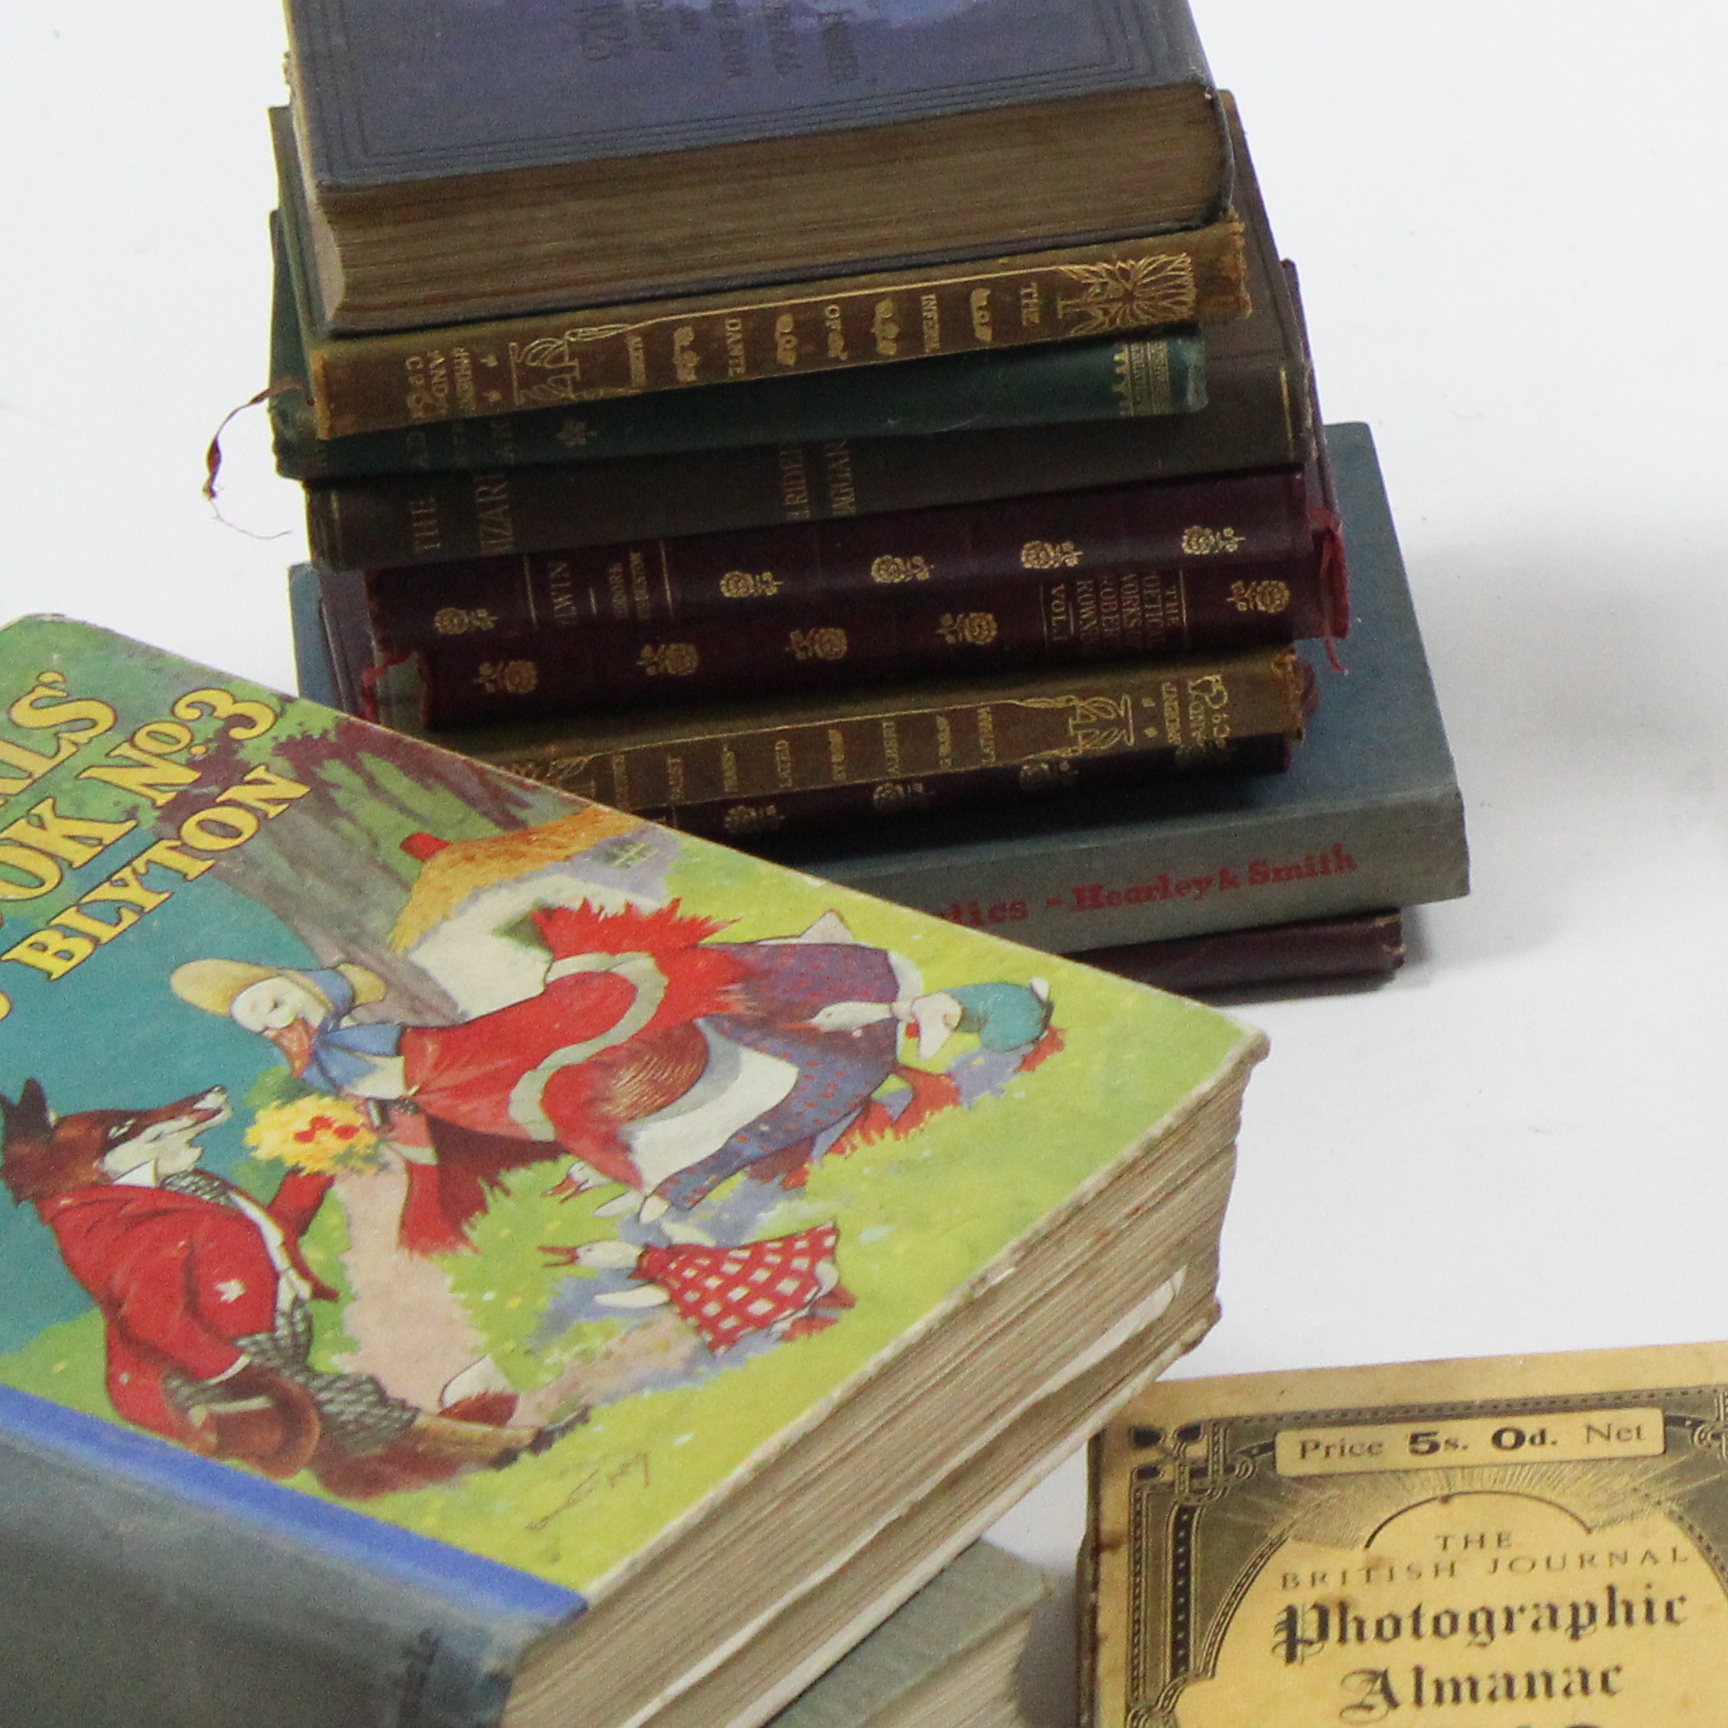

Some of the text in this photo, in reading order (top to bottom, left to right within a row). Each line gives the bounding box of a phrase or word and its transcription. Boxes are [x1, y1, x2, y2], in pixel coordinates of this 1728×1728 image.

[1019, 281, 1041, 327] THE
[724, 316, 747, 379] DANTE
[409, 496, 441, 555] THE
[1165, 585, 1181, 628] THE
[774, 738, 794, 789] LATED
[0, 765, 312, 981] BLYTON
[1218, 869, 1240, 892] &
[1249, 842, 1359, 887] Smith
[1299, 1436, 1384, 1460] Price
[1408, 1430, 1470, 1455] 5s.
[1584, 1422, 1647, 1444] Net
[1435, 1531, 1513, 1552] THE
[1280, 1547, 1690, 1591] BRITISH JOURNAL
[1271, 1583, 1688, 1666] Photographic
[1338, 1664, 1624, 1724] Almanac
